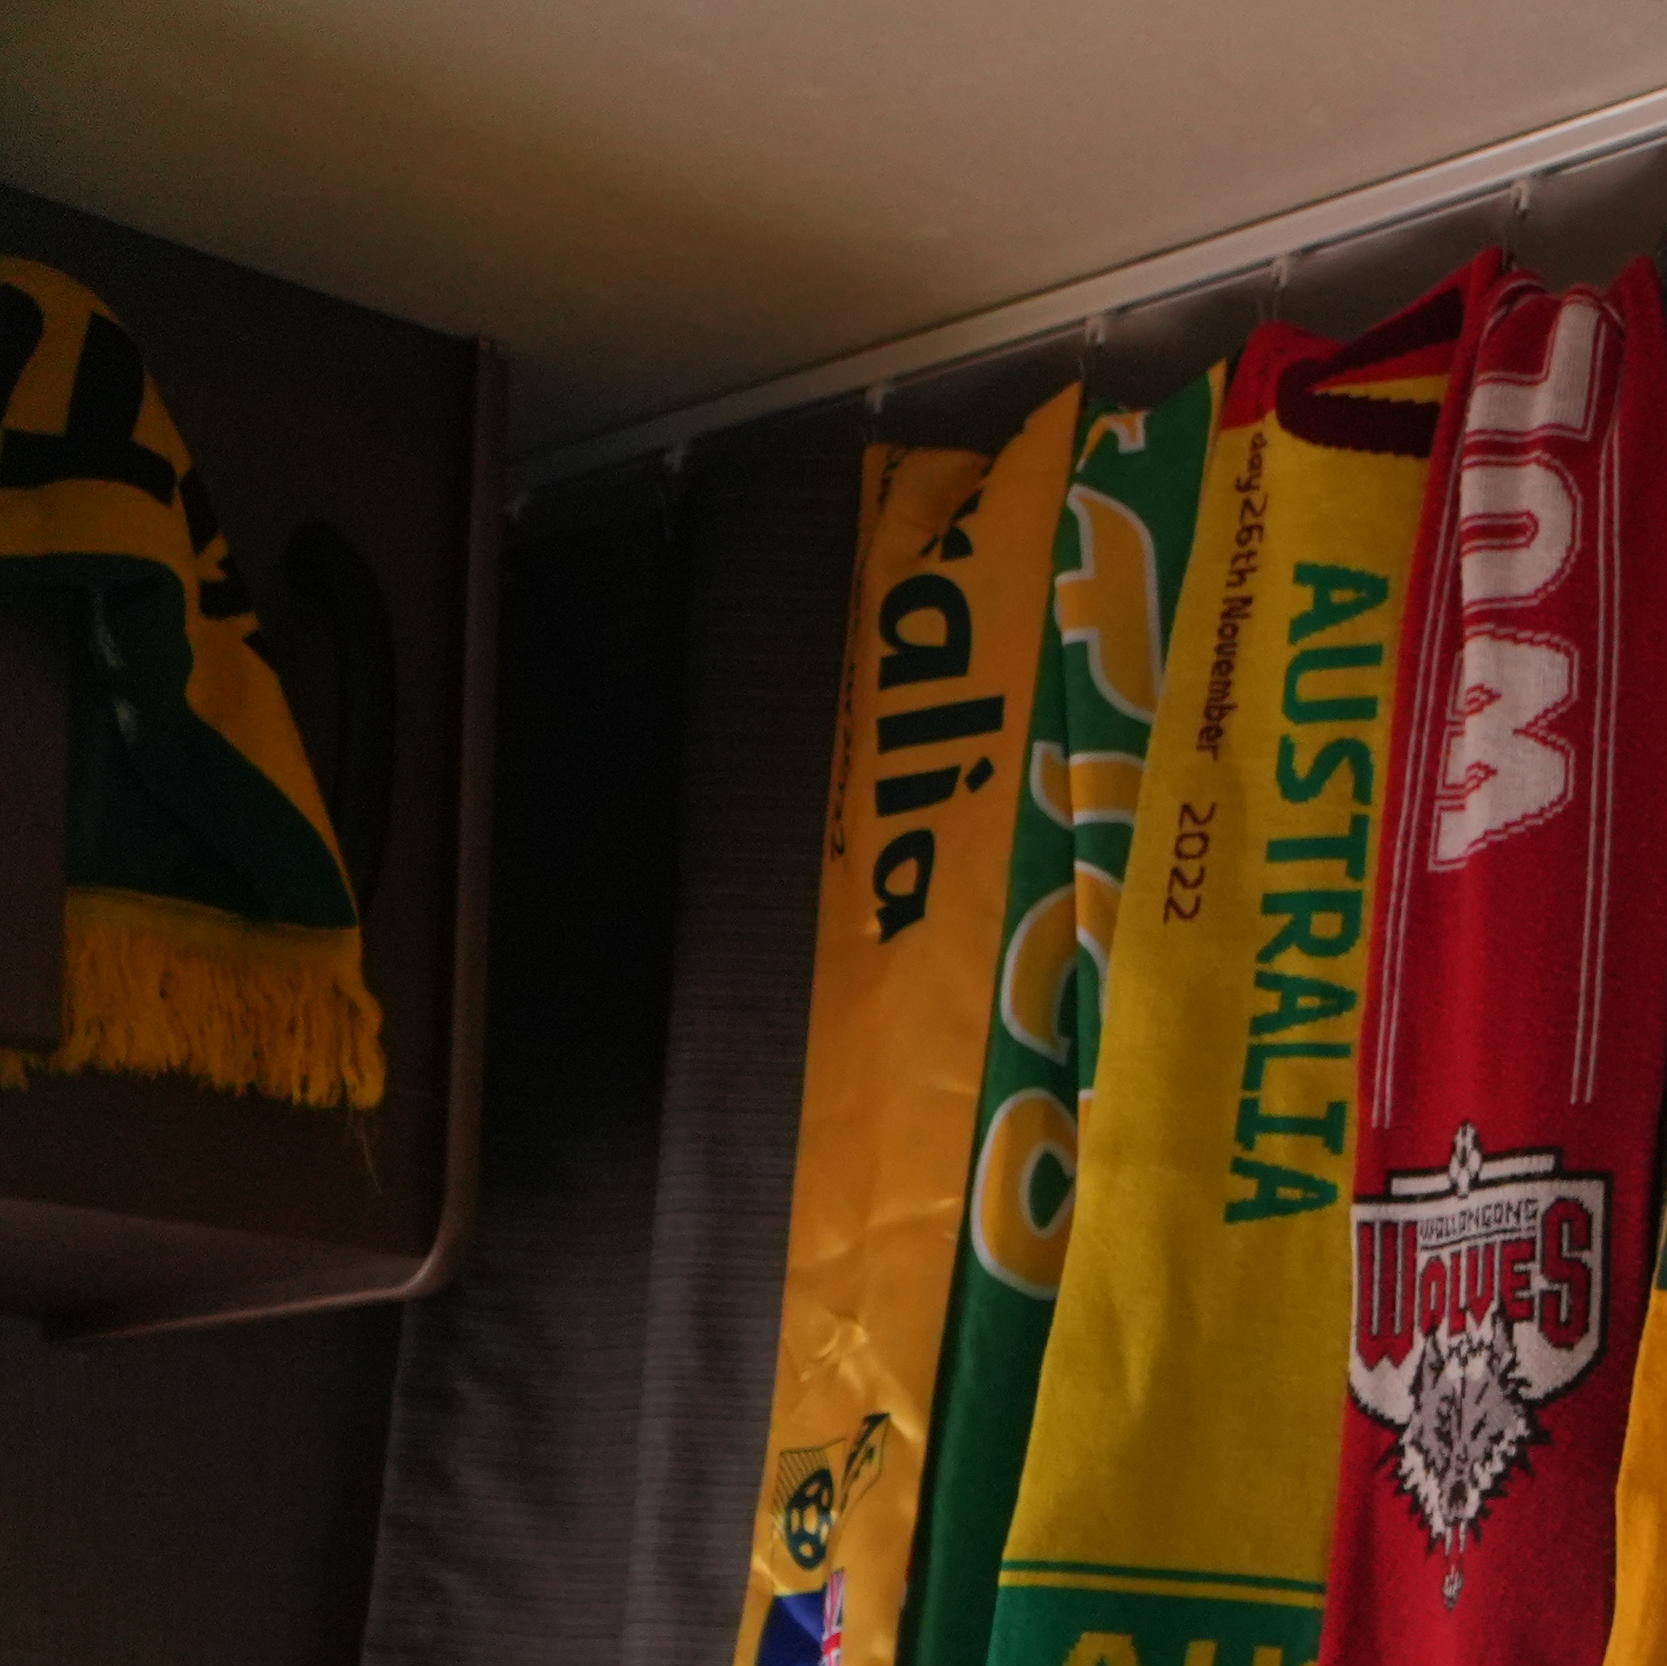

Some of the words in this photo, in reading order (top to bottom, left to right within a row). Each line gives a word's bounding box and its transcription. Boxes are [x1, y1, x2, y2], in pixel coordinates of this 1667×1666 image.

[1195, 595, 1255, 762] November
[1161, 802, 1218, 924] 2022
[1224, 562, 1391, 1225] AUSTRALIA
[1355, 1196, 1593, 1372] WOLVES
